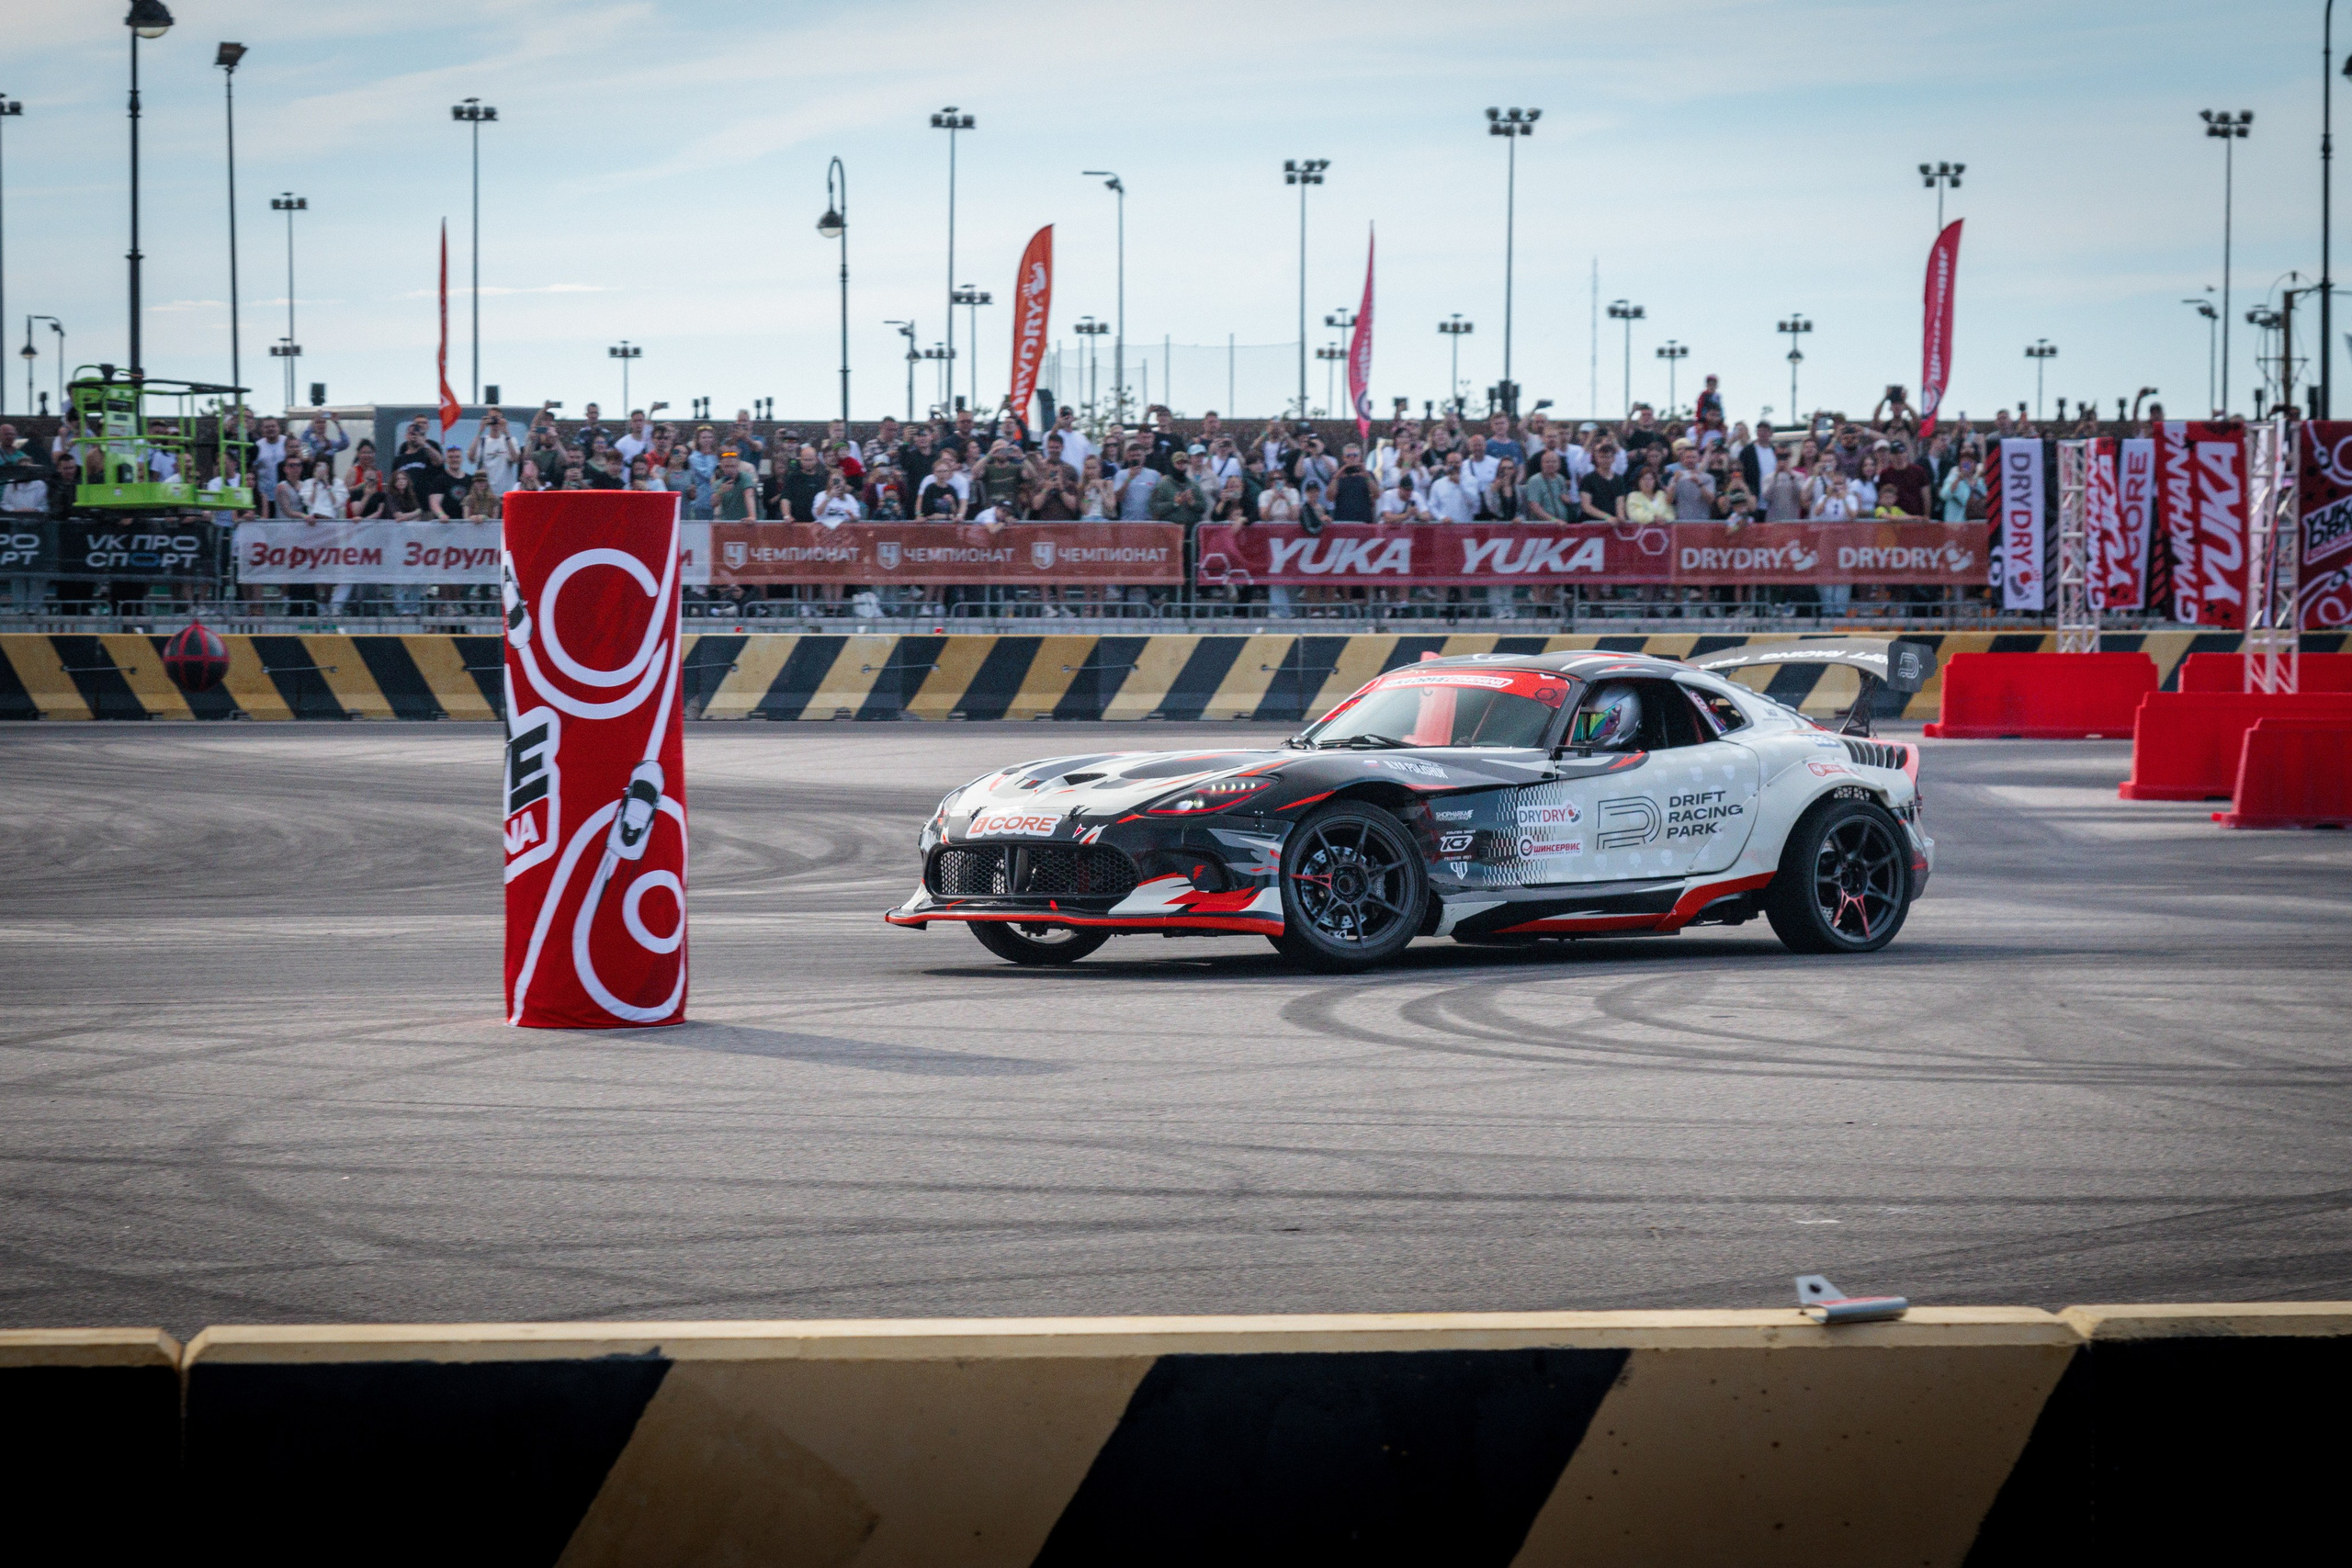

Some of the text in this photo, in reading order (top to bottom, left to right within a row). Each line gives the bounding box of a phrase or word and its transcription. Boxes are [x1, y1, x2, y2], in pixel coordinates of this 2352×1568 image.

[2009, 452, 2033, 566] DRYDRY
[2163, 422, 2198, 625] GYMKHANA
[2197, 441, 2244, 605] YUKA
[85, 552, 199, 568] СПОРТ
[249, 542, 382, 570] Зарулем
[750, 547, 860, 561] ЧЕМПИОНАТ
[903, 547, 1014, 562] ЧЕМПИОНАТ
[1058, 547, 1169, 562] ЧЕМПИОНАТ
[1268, 537, 1605, 574] YUKA YUKA
[1680, 547, 1940, 570] DRYDRY DRYDRY
[1759, 650, 1846, 660] RACING
[1669, 791, 1726, 808] DRIFT
[1519, 808, 1566, 824] DRYDRY
[1668, 805, 1744, 823] RACING
[1666, 822, 1718, 839] PARK
[1533, 842, 1580, 853] ШИНСЕРВИС
